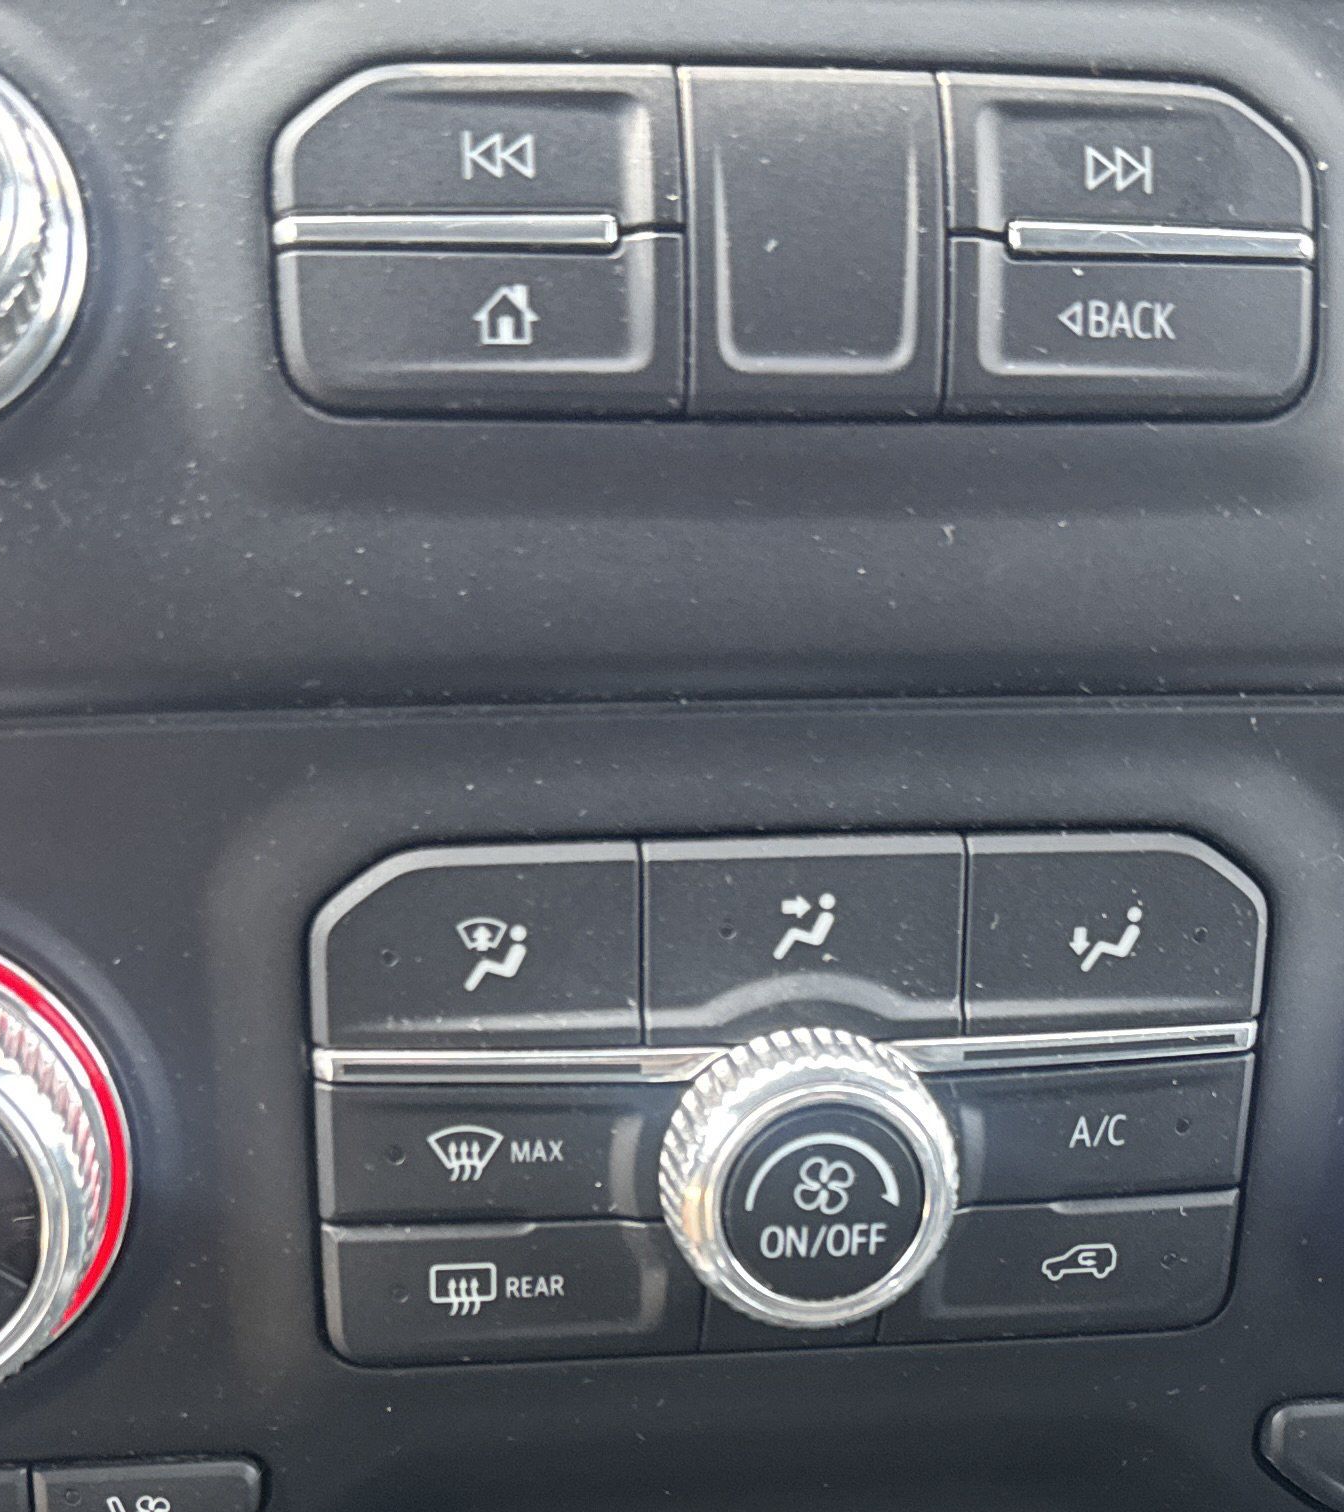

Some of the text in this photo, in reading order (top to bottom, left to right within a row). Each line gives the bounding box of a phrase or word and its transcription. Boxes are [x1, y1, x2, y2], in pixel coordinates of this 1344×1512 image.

[1087, 300, 1176, 340] BACK
[1069, 1114, 1127, 1149] A/C
[510, 1140, 564, 1164] MAX
[759, 1222, 888, 1260] ON/OFF
[505, 1275, 565, 1299] REAR
